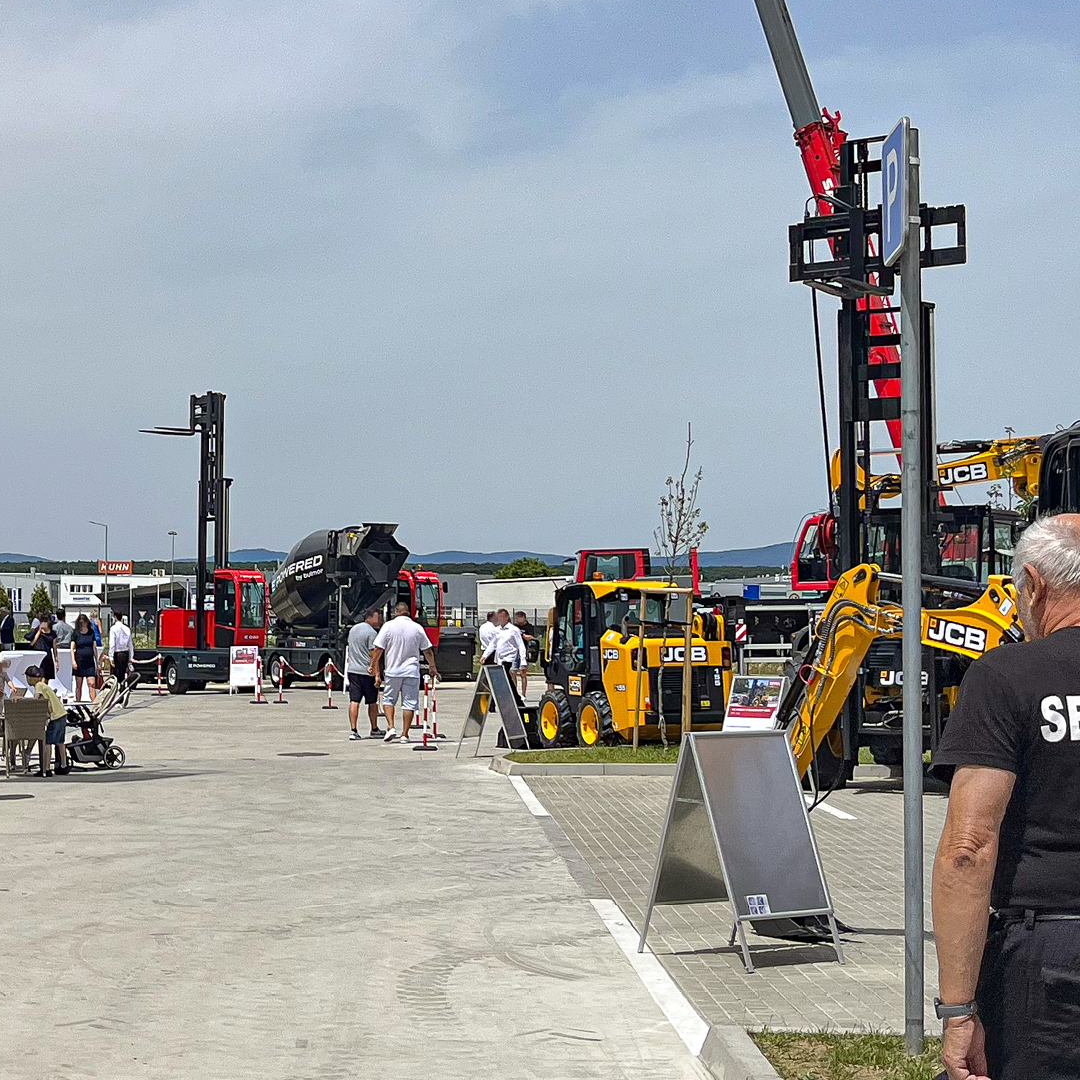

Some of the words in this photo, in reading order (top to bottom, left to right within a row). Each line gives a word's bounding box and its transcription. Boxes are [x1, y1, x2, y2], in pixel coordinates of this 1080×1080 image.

[886, 148, 898, 243] P
[939, 463, 988, 485] JCB
[100, 563, 130, 571] KUHN
[928, 620, 986, 652] JCB
[602, 649, 619, 660] JCB
[663, 647, 707, 662] JCB
[1041, 695, 1080, 743] SE
